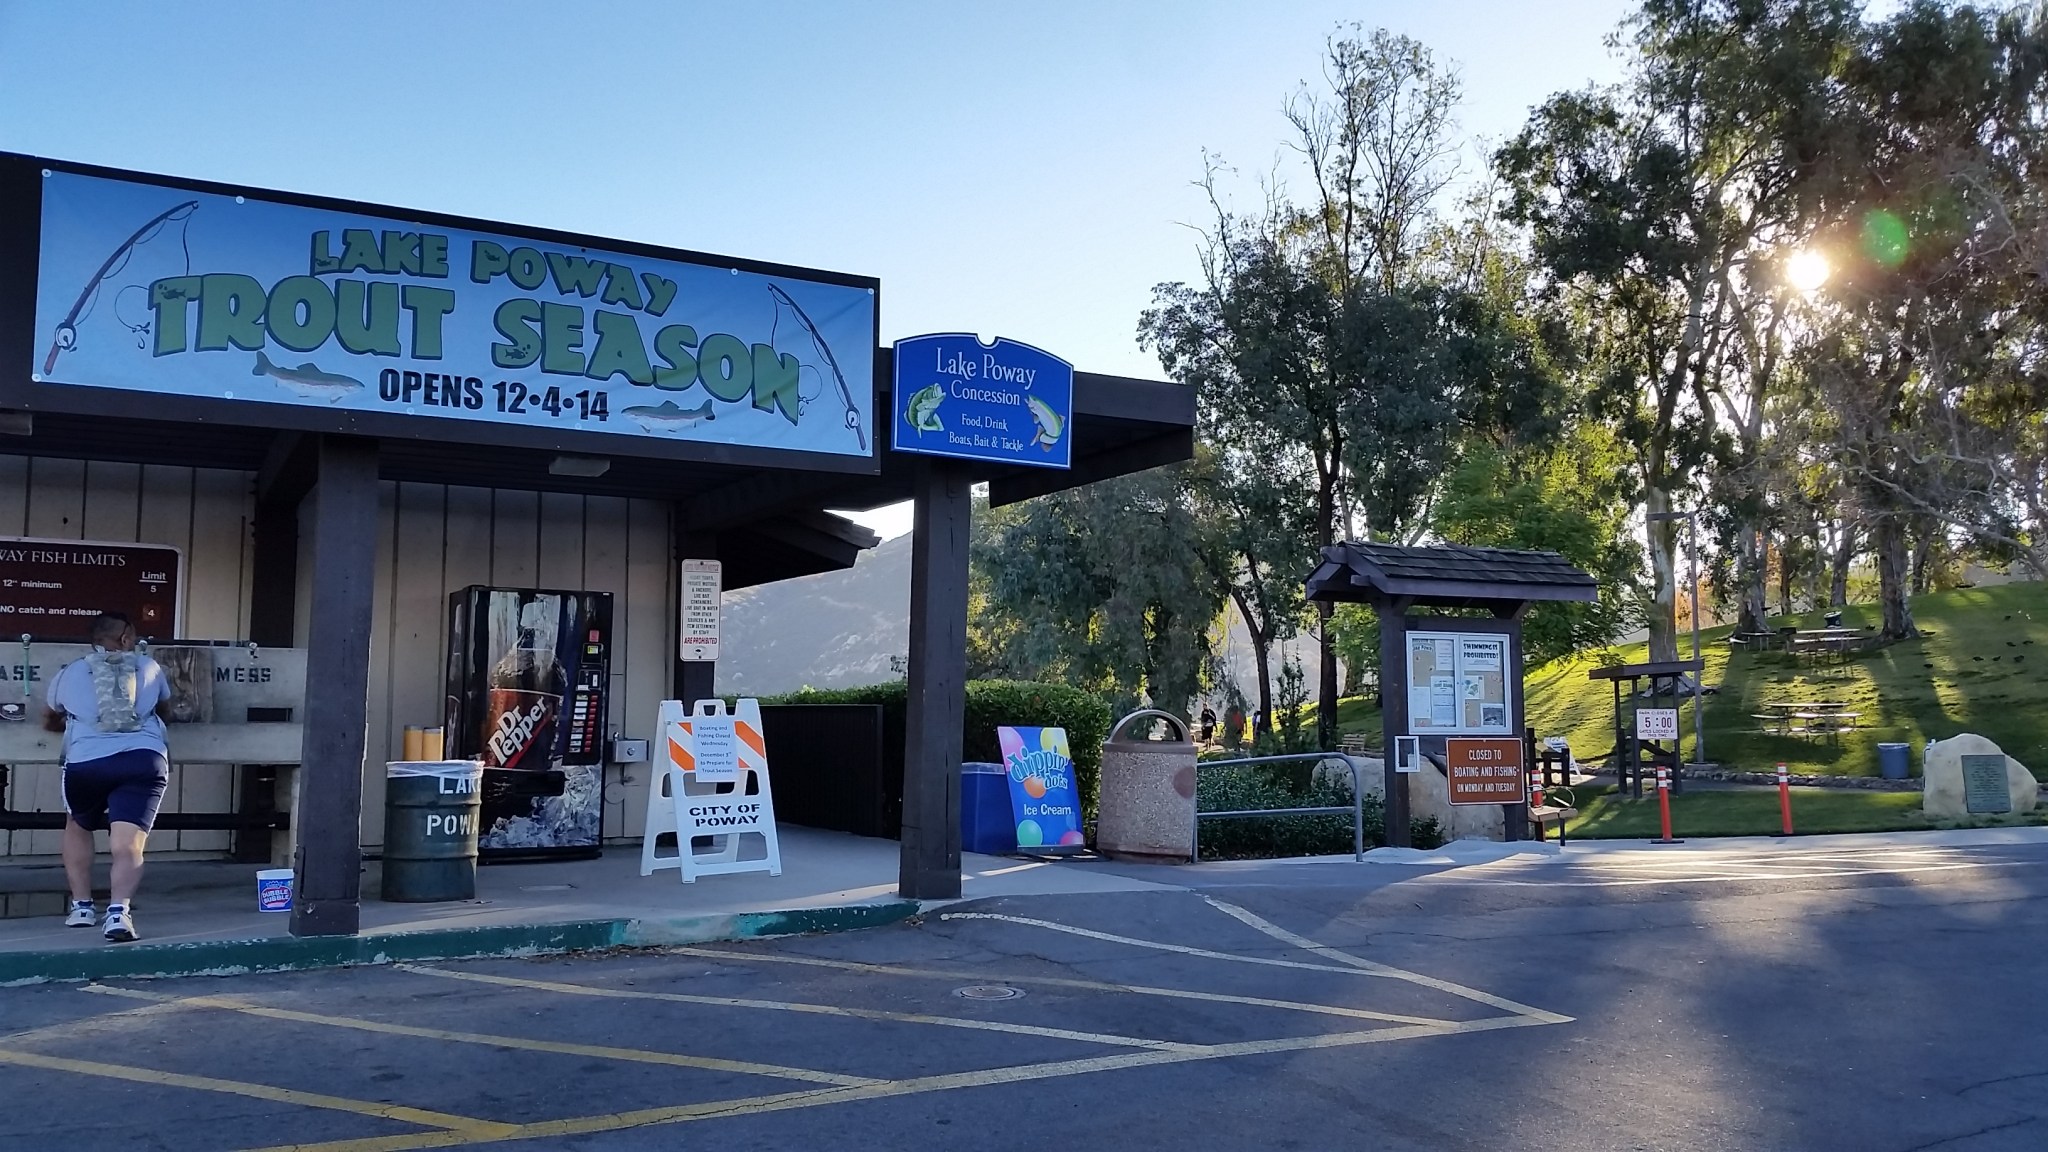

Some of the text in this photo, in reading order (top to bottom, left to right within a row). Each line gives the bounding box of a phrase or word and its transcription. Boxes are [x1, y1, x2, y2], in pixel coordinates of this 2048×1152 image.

[310, 228, 678, 317] LAKE POWAY
[148, 273, 800, 426] TROUT SEASON
[936, 347, 1036, 390] Lake Poway
[378, 368, 483, 411] OPENS
[951, 379, 1020, 406] Concession
[961, 413, 1008, 432] Food, Drink
[949, 431, 1024, 452] Boats, Bait & Tackle
[31, 550, 67, 564] FISH
[72, 552, 126, 567] LIMITS
[141, 570, 167, 581] Limit
[21, 580, 63, 589] minimum
[150, 585, 157, 593] 5
[0, 605, 15, 613] NO
[18, 606, 45, 614] catch
[48, 607, 66, 615] and
[147, 609, 155, 617] 4
[216, 667, 271, 682] MESS
[497, 704, 523, 732] Dr
[487, 696, 548, 766] Pepper
[1468, 749, 1502, 761] CLOSED TO
[1454, 766, 1517, 777] BOATING AND FISHING
[1044, 772, 1068, 789] dots
[1457, 783, 1516, 793] ON MONDAY AND TUESDAY
[689, 803, 761, 816] CITY OF
[1024, 803, 1072, 815] Ice Cream
[695, 815, 760, 828] POWAY
